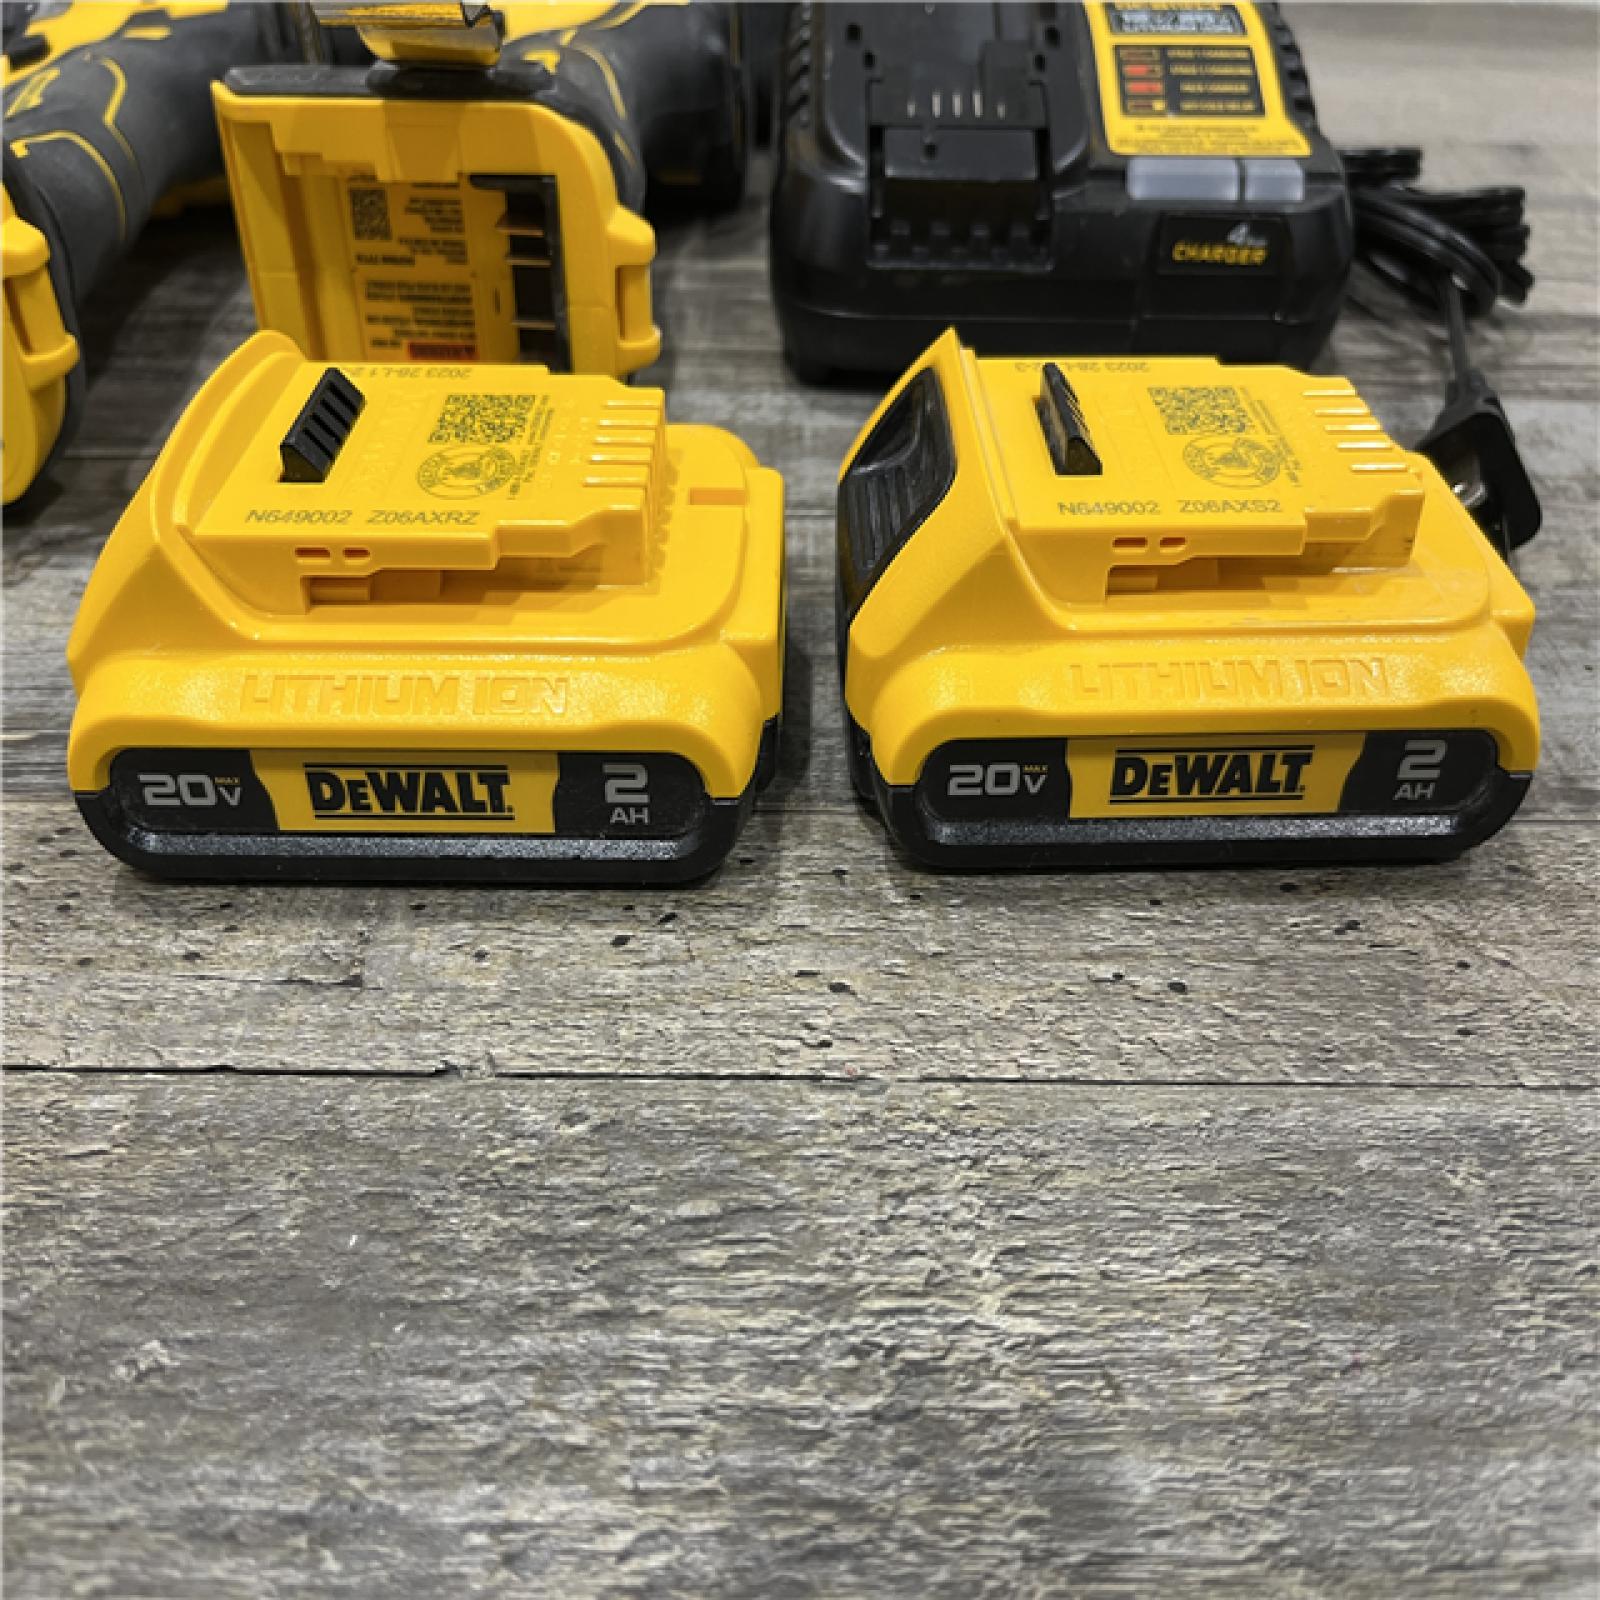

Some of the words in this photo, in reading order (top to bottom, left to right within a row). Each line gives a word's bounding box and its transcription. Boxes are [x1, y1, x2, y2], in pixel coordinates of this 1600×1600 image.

[1172, 241, 1268, 265] CHARGER
[245, 509, 353, 524] N649002
[1057, 500, 1162, 516] N649002
[240, 674, 459, 717] LITHIUM
[473, 676, 568, 717] ION
[1069, 659, 1286, 700] LITHIUM
[1297, 658, 1389, 698] ION
[1110, 752, 1311, 798] DEWALT
[1397, 739, 1447, 779] 2
[306, 770, 510, 814] DEWALT
[603, 764, 648, 803] 2
[1392, 782, 1436, 801] AH
[609, 806, 649, 825] AH
